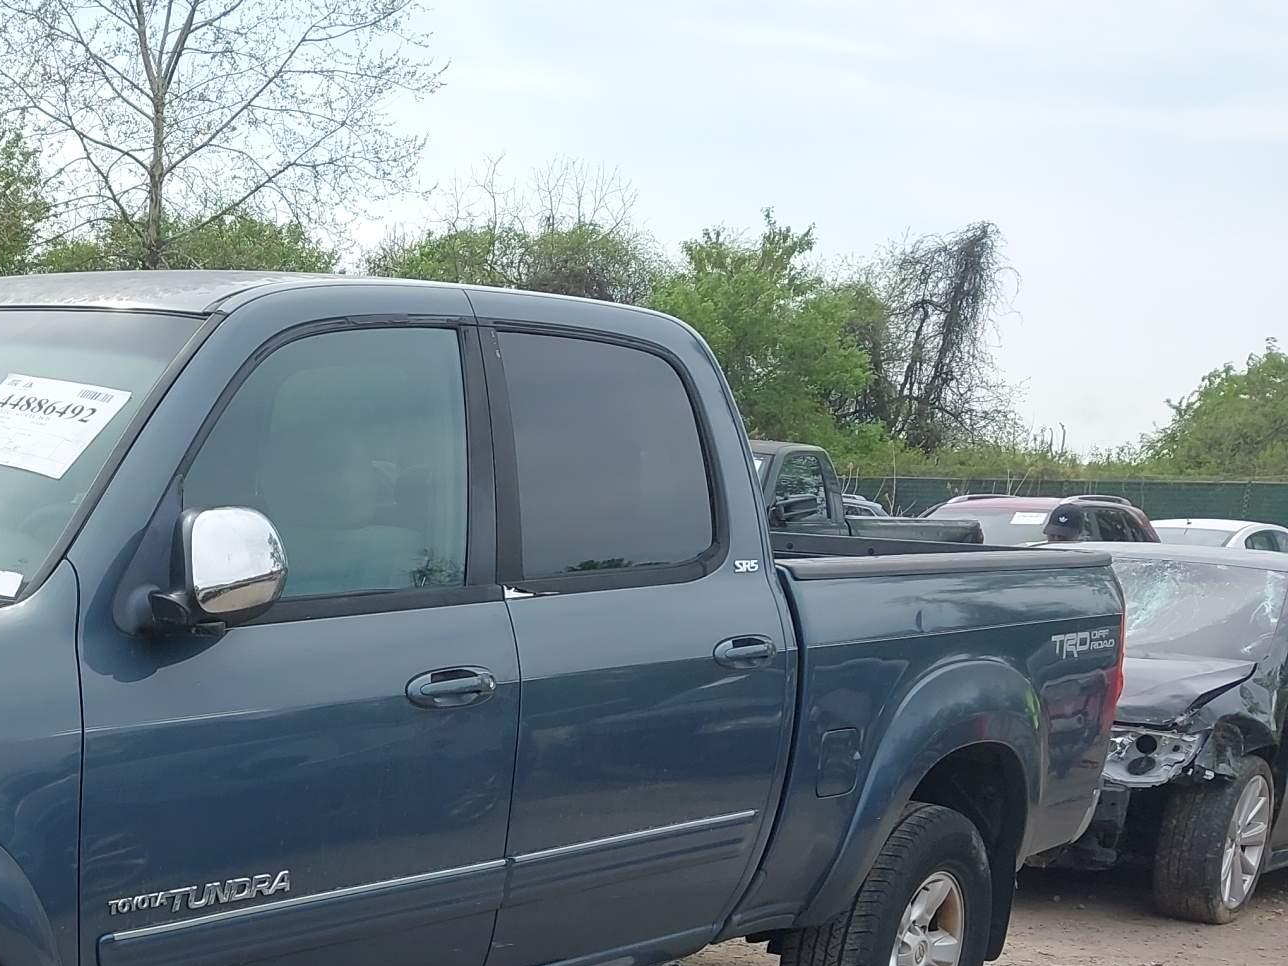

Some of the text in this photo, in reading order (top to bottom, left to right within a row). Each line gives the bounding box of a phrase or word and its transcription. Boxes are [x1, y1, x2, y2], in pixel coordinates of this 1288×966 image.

[734, 560, 759, 572] SR5
[1091, 629, 1110, 639] OFF
[1051, 631, 1090, 660] TRD
[1090, 639, 1115, 650] ROAD
[108, 870, 291, 916] TOYOTA TUNDRA
